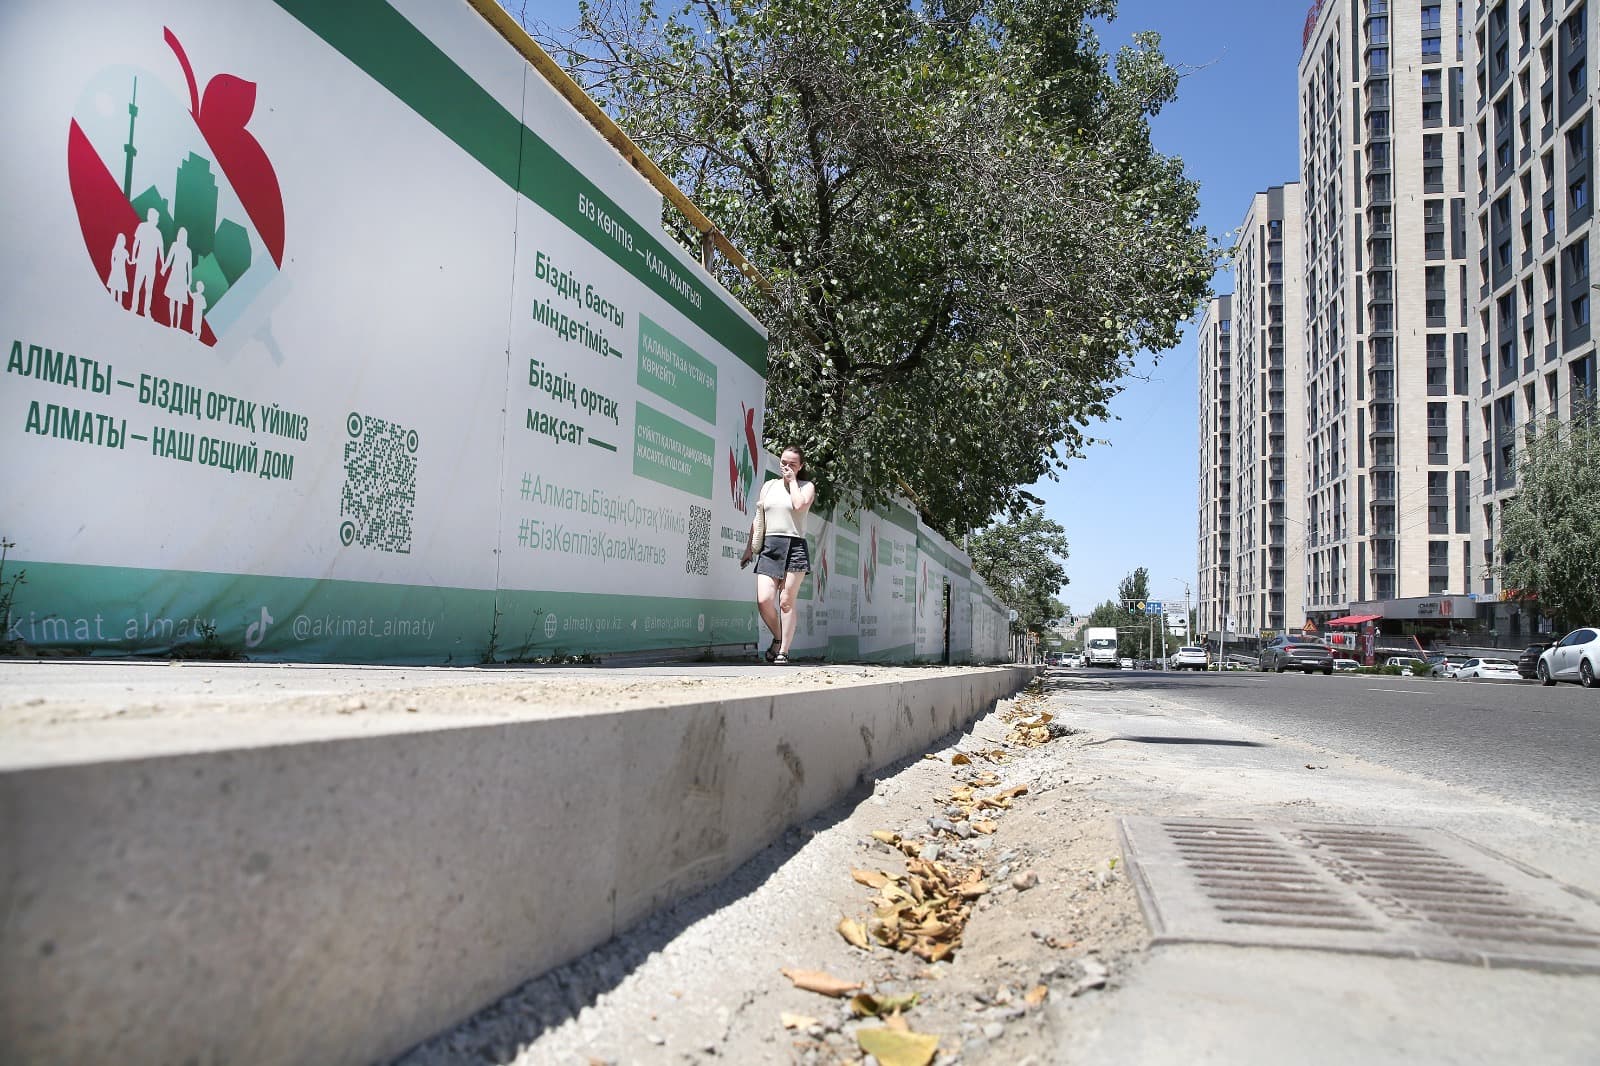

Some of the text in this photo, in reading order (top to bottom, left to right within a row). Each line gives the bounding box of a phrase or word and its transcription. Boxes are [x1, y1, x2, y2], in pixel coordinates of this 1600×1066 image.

[577, 192, 595, 218] БІЗ
[597, 207, 633, 252] КӨППІЗ
[646, 249, 669, 283] ҚАЛА
[535, 250, 624, 329] Біздің басты
[7, 340, 112, 396] АЛМАТЫ
[138, 373, 202, 421] БІЗДІҢ
[206, 391, 256, 433] ОРТАҚ
[261, 403, 310, 443] ҮЙІМІЗ
[528, 358, 619, 426] Біздің ортақ
[25, 400, 127, 450] АЛМАТЫ
[152, 426, 195, 463] НАШ
[198, 436, 258, 474] ОБЩИЙ
[259, 450, 294, 481] ДОМ
[526, 408, 584, 446] мақсат
[520, 471, 686, 535] #АлматыБіздіңОртақҮйіміз
[517, 518, 667, 566] #БізКөппізҚалаЖалғыз
[292, 614, 435, 641] @akimat_almaty
[562, 616, 622, 633] almaty.gov.kz
